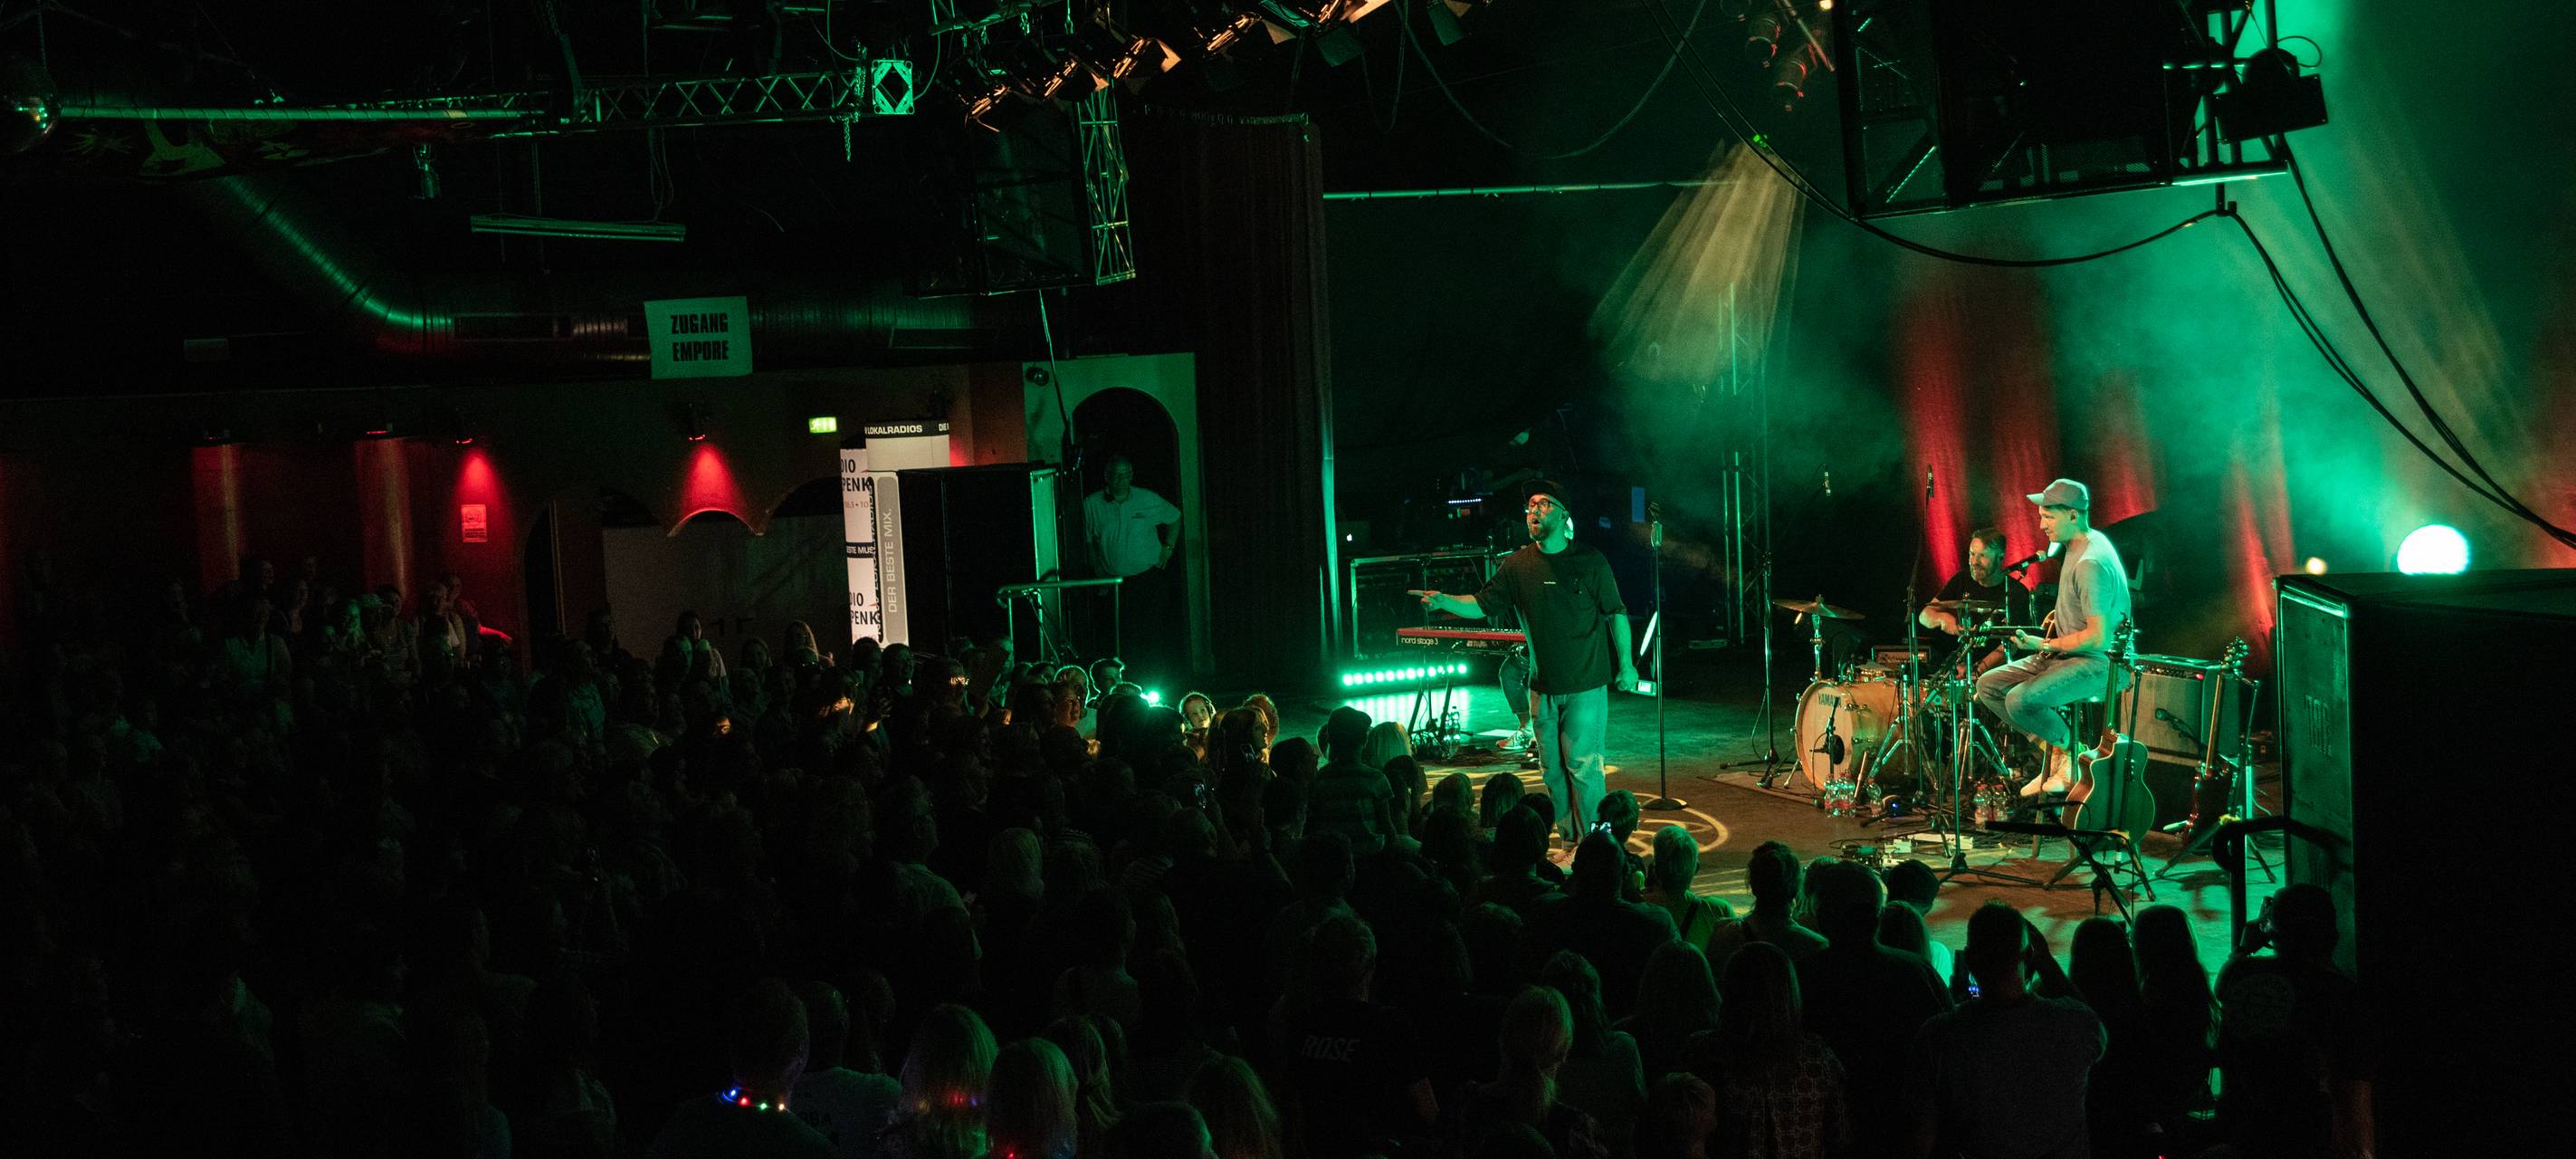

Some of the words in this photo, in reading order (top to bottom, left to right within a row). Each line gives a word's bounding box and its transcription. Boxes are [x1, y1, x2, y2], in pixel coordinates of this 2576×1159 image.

[671, 312, 729, 334] ZUGANG
[673, 340, 729, 362] EMPORE
[883, 508, 893, 537] MIX.
[885, 541, 895, 582] BESTE
[888, 586, 898, 613] DER
[1401, 637, 1416, 645] nord
[1417, 637, 1435, 647] stage
[1435, 637, 1439, 646] 3
